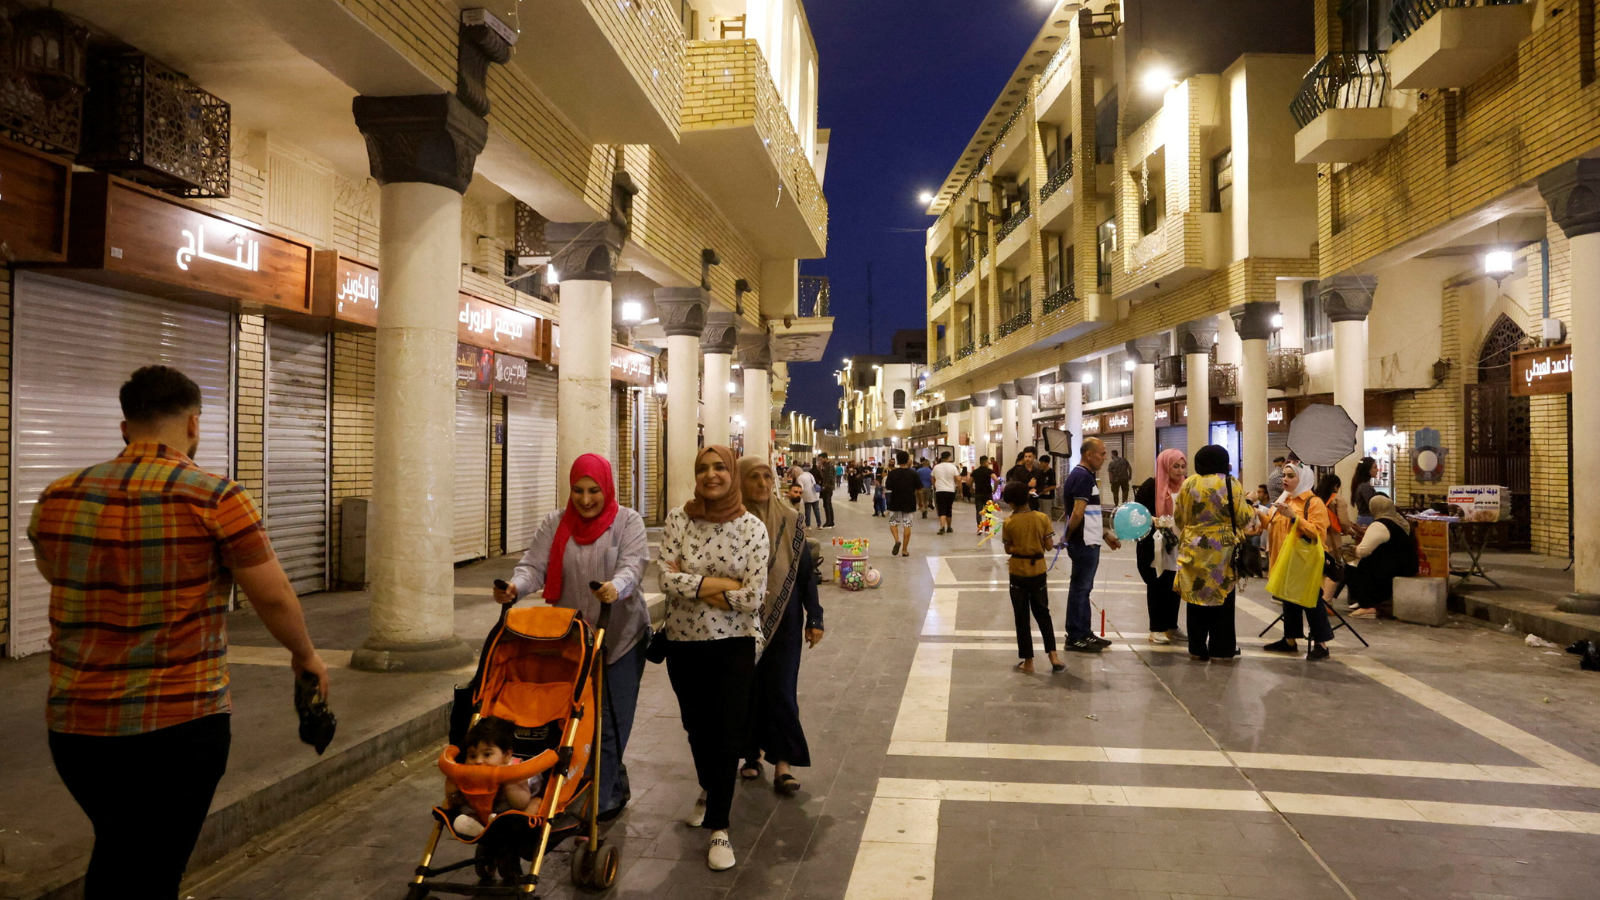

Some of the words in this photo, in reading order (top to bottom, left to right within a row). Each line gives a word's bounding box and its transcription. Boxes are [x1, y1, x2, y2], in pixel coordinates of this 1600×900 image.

[176, 225, 259, 271] التاج
[337, 271, 369, 307] الكويتي
[458, 302, 492, 334] الزوراء
[493, 317, 523, 342] مجمع
[1551, 354, 1569, 374] احمد
